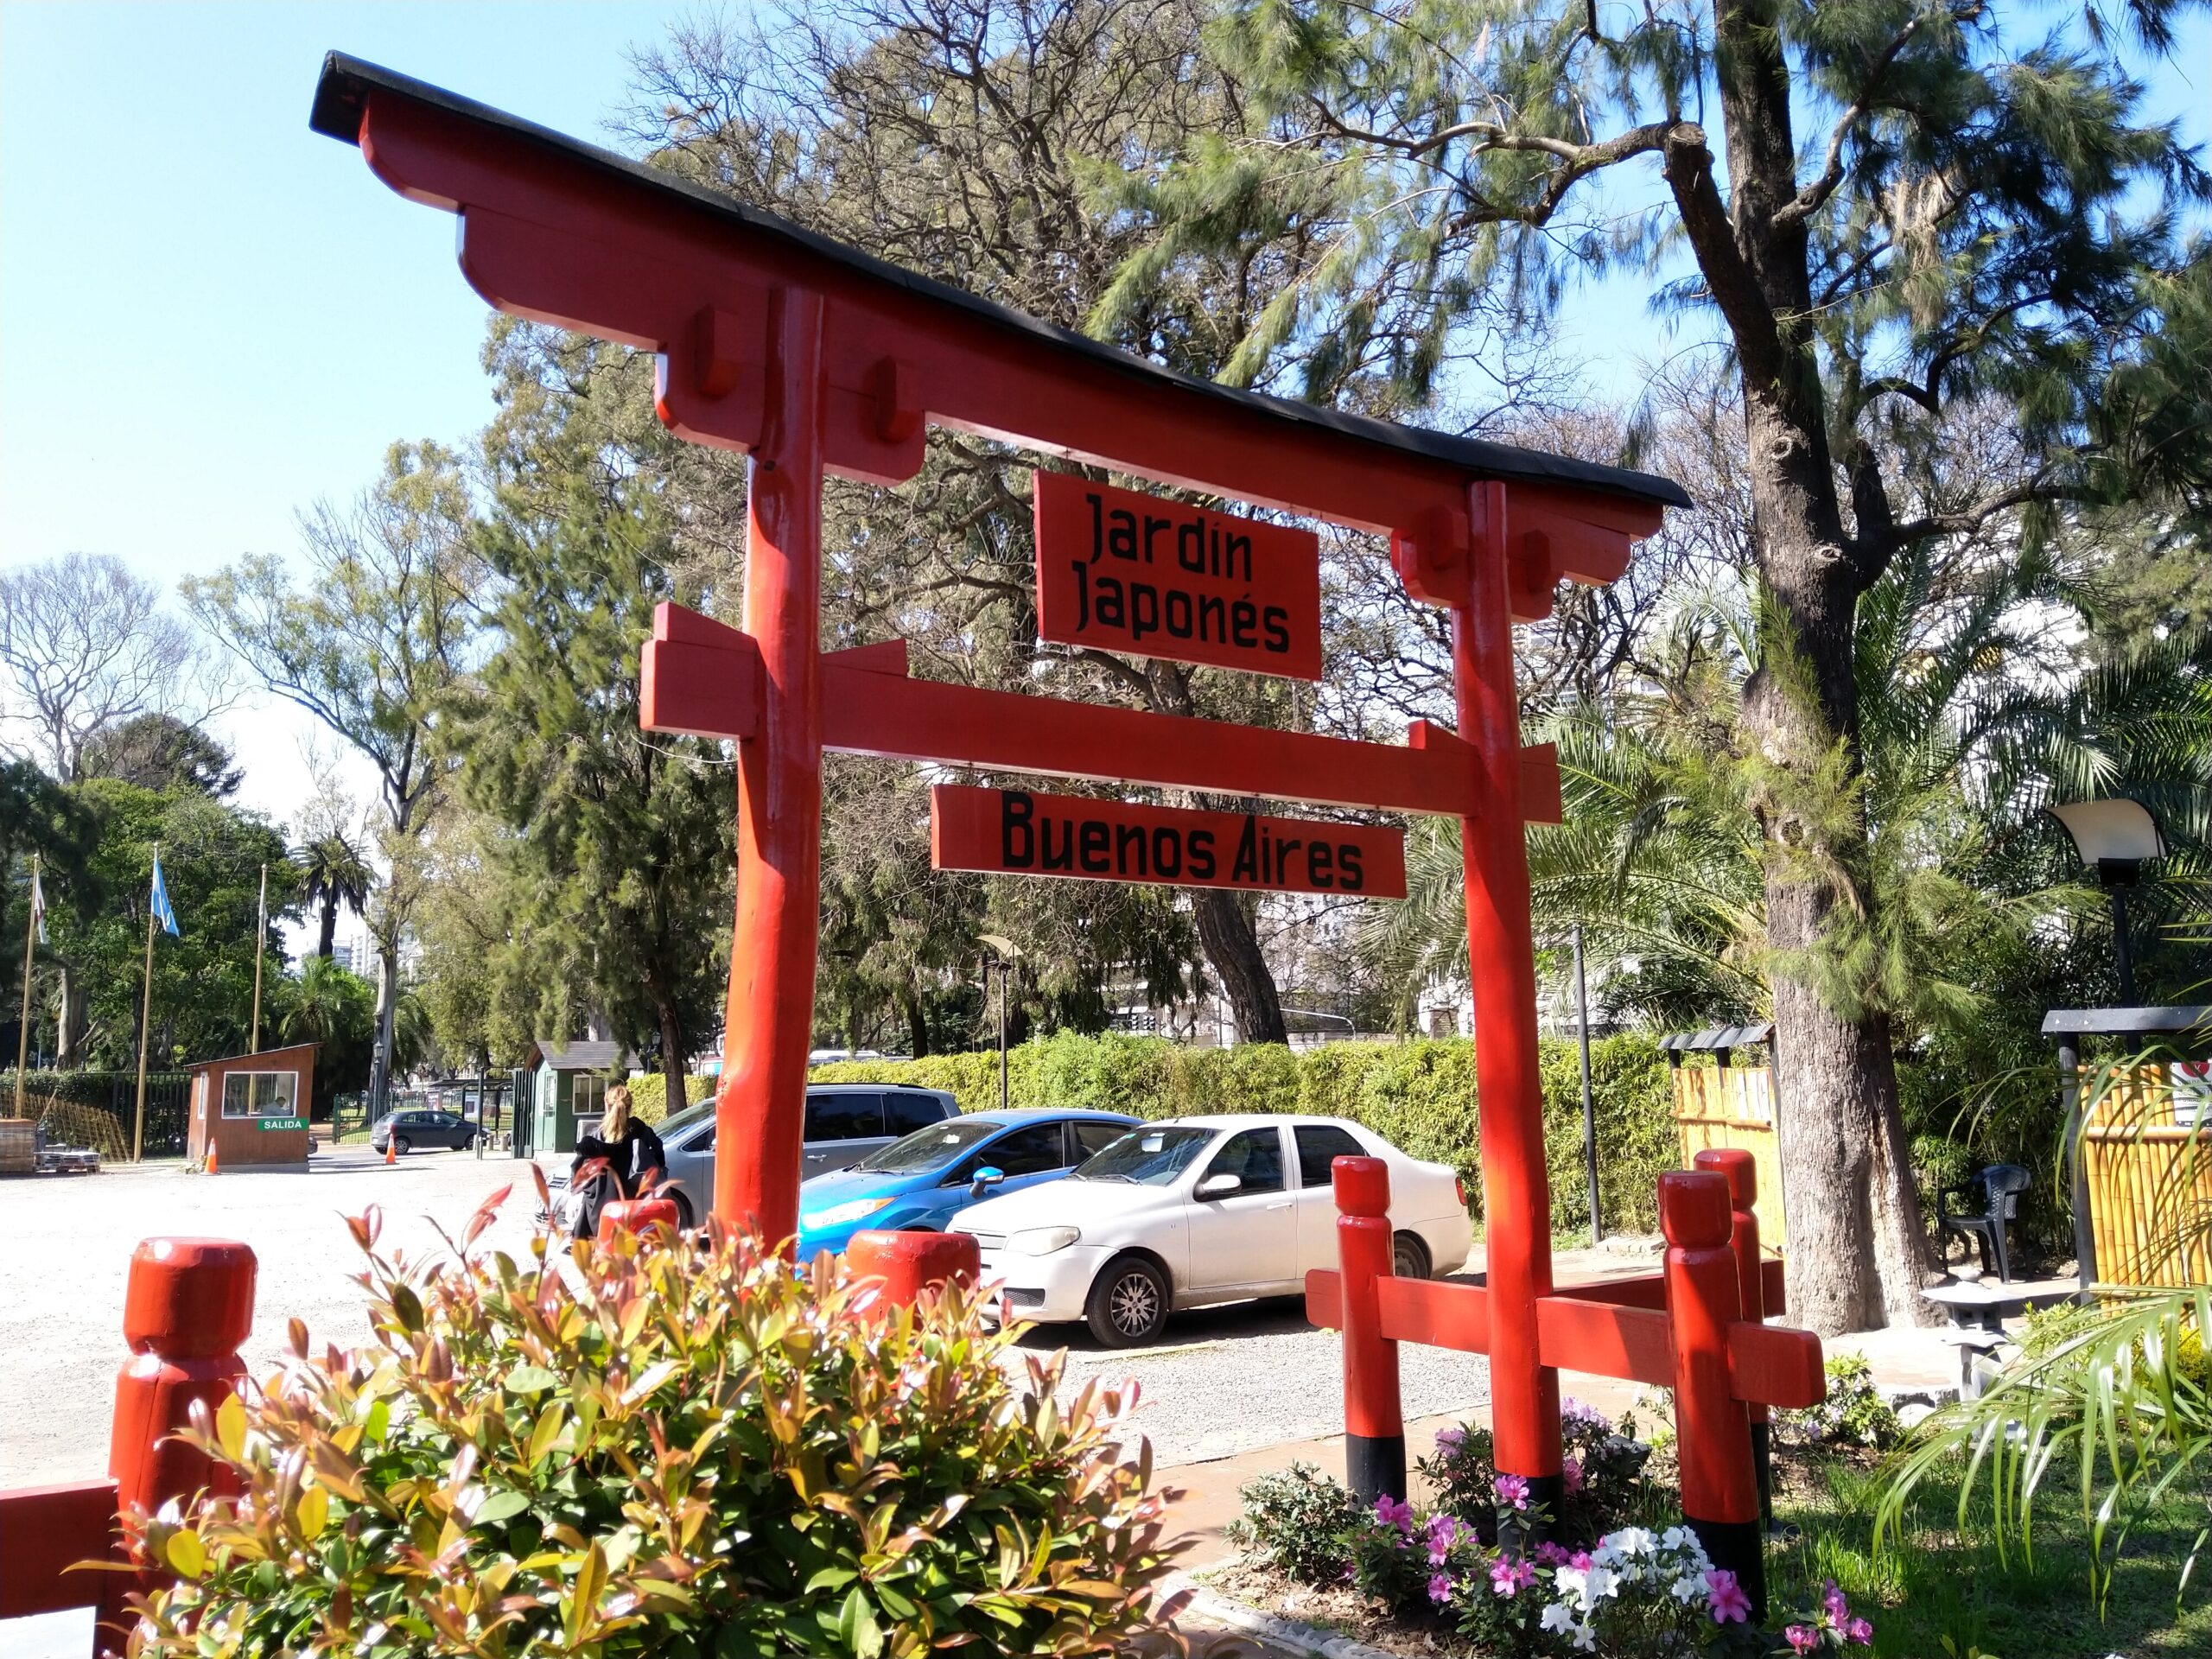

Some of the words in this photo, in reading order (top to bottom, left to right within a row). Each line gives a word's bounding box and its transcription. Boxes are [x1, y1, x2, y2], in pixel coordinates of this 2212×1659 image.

[1086, 494, 1253, 582] Jardín
[1071, 561, 1290, 654] Japonés
[1001, 791, 1217, 880] Buenos
[1231, 814, 1364, 892] Aires
[264, 1121, 302, 1129] SALIDA
